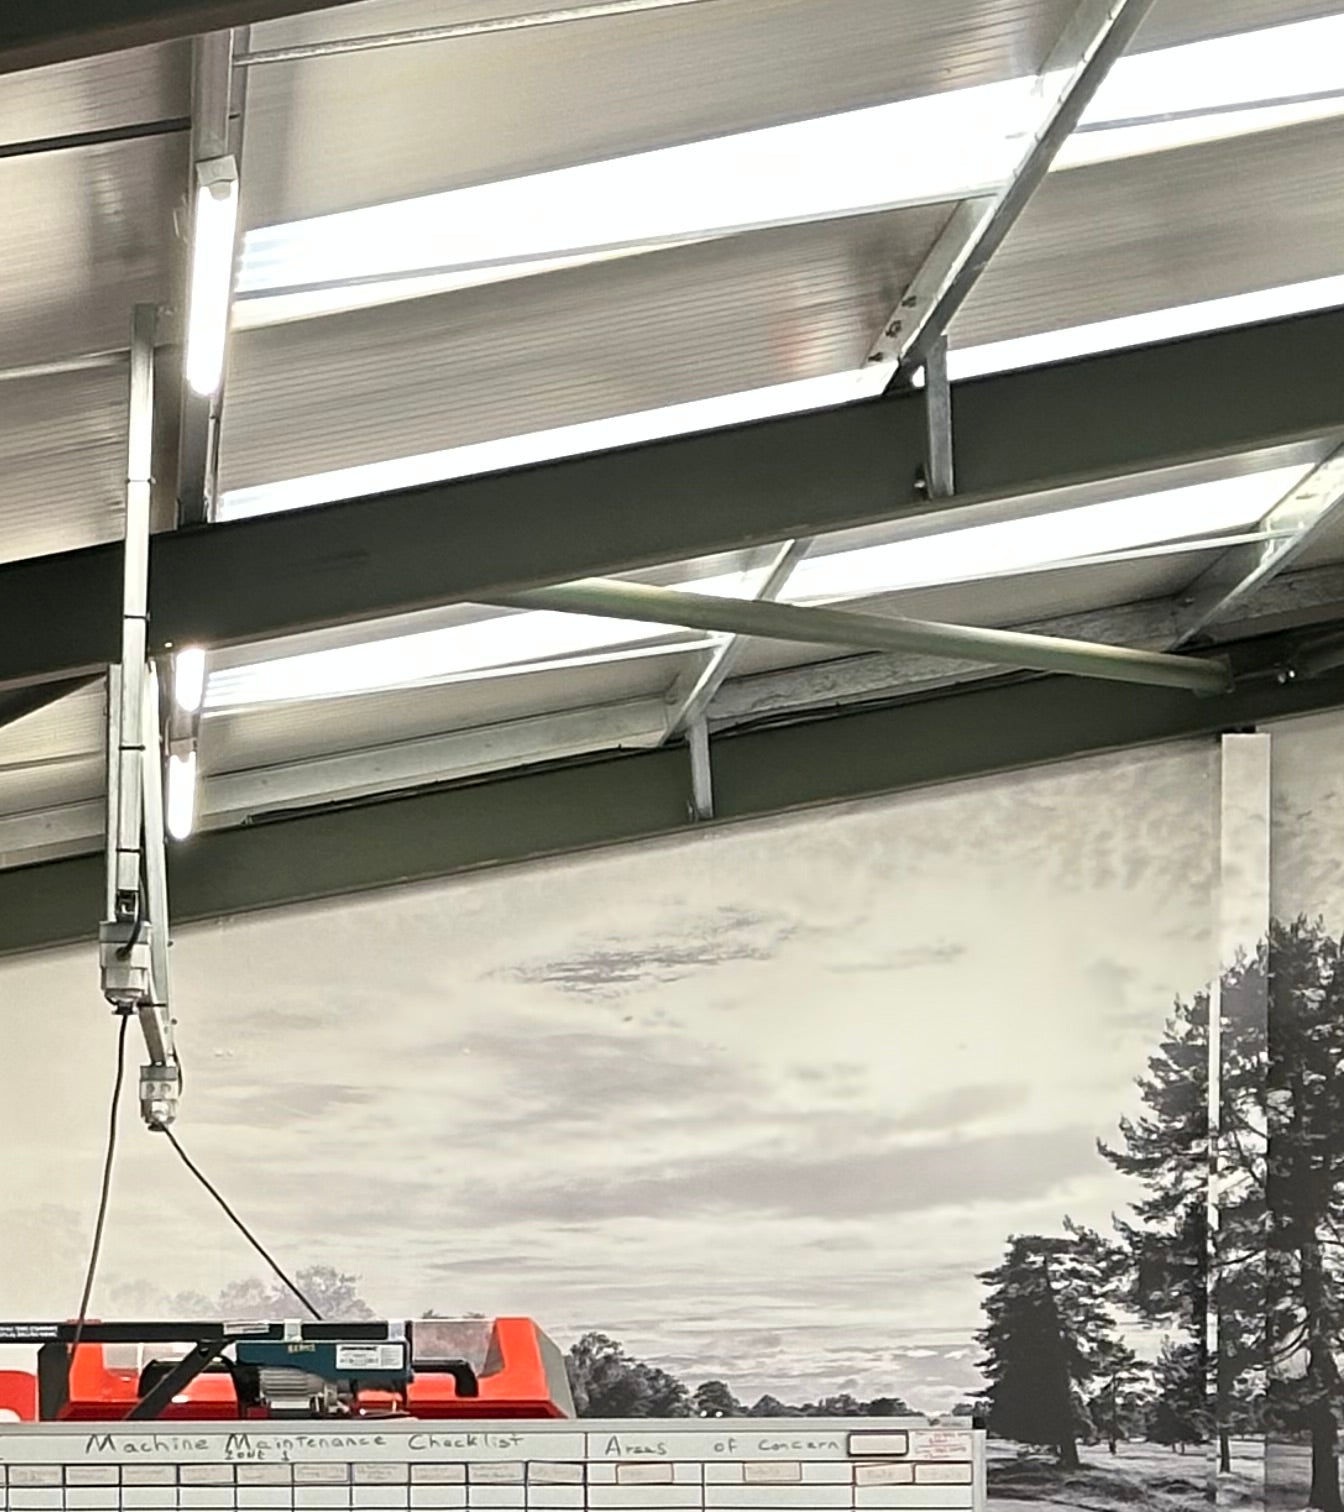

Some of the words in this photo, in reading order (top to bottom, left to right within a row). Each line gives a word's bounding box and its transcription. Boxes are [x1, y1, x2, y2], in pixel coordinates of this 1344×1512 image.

[85, 1433, 209, 1454] Machine
[225, 1432, 387, 1452] Maintenance
[408, 1434, 525, 1451] Checklist
[605, 1435, 668, 1456] Areas
[713, 1435, 738, 1453] of
